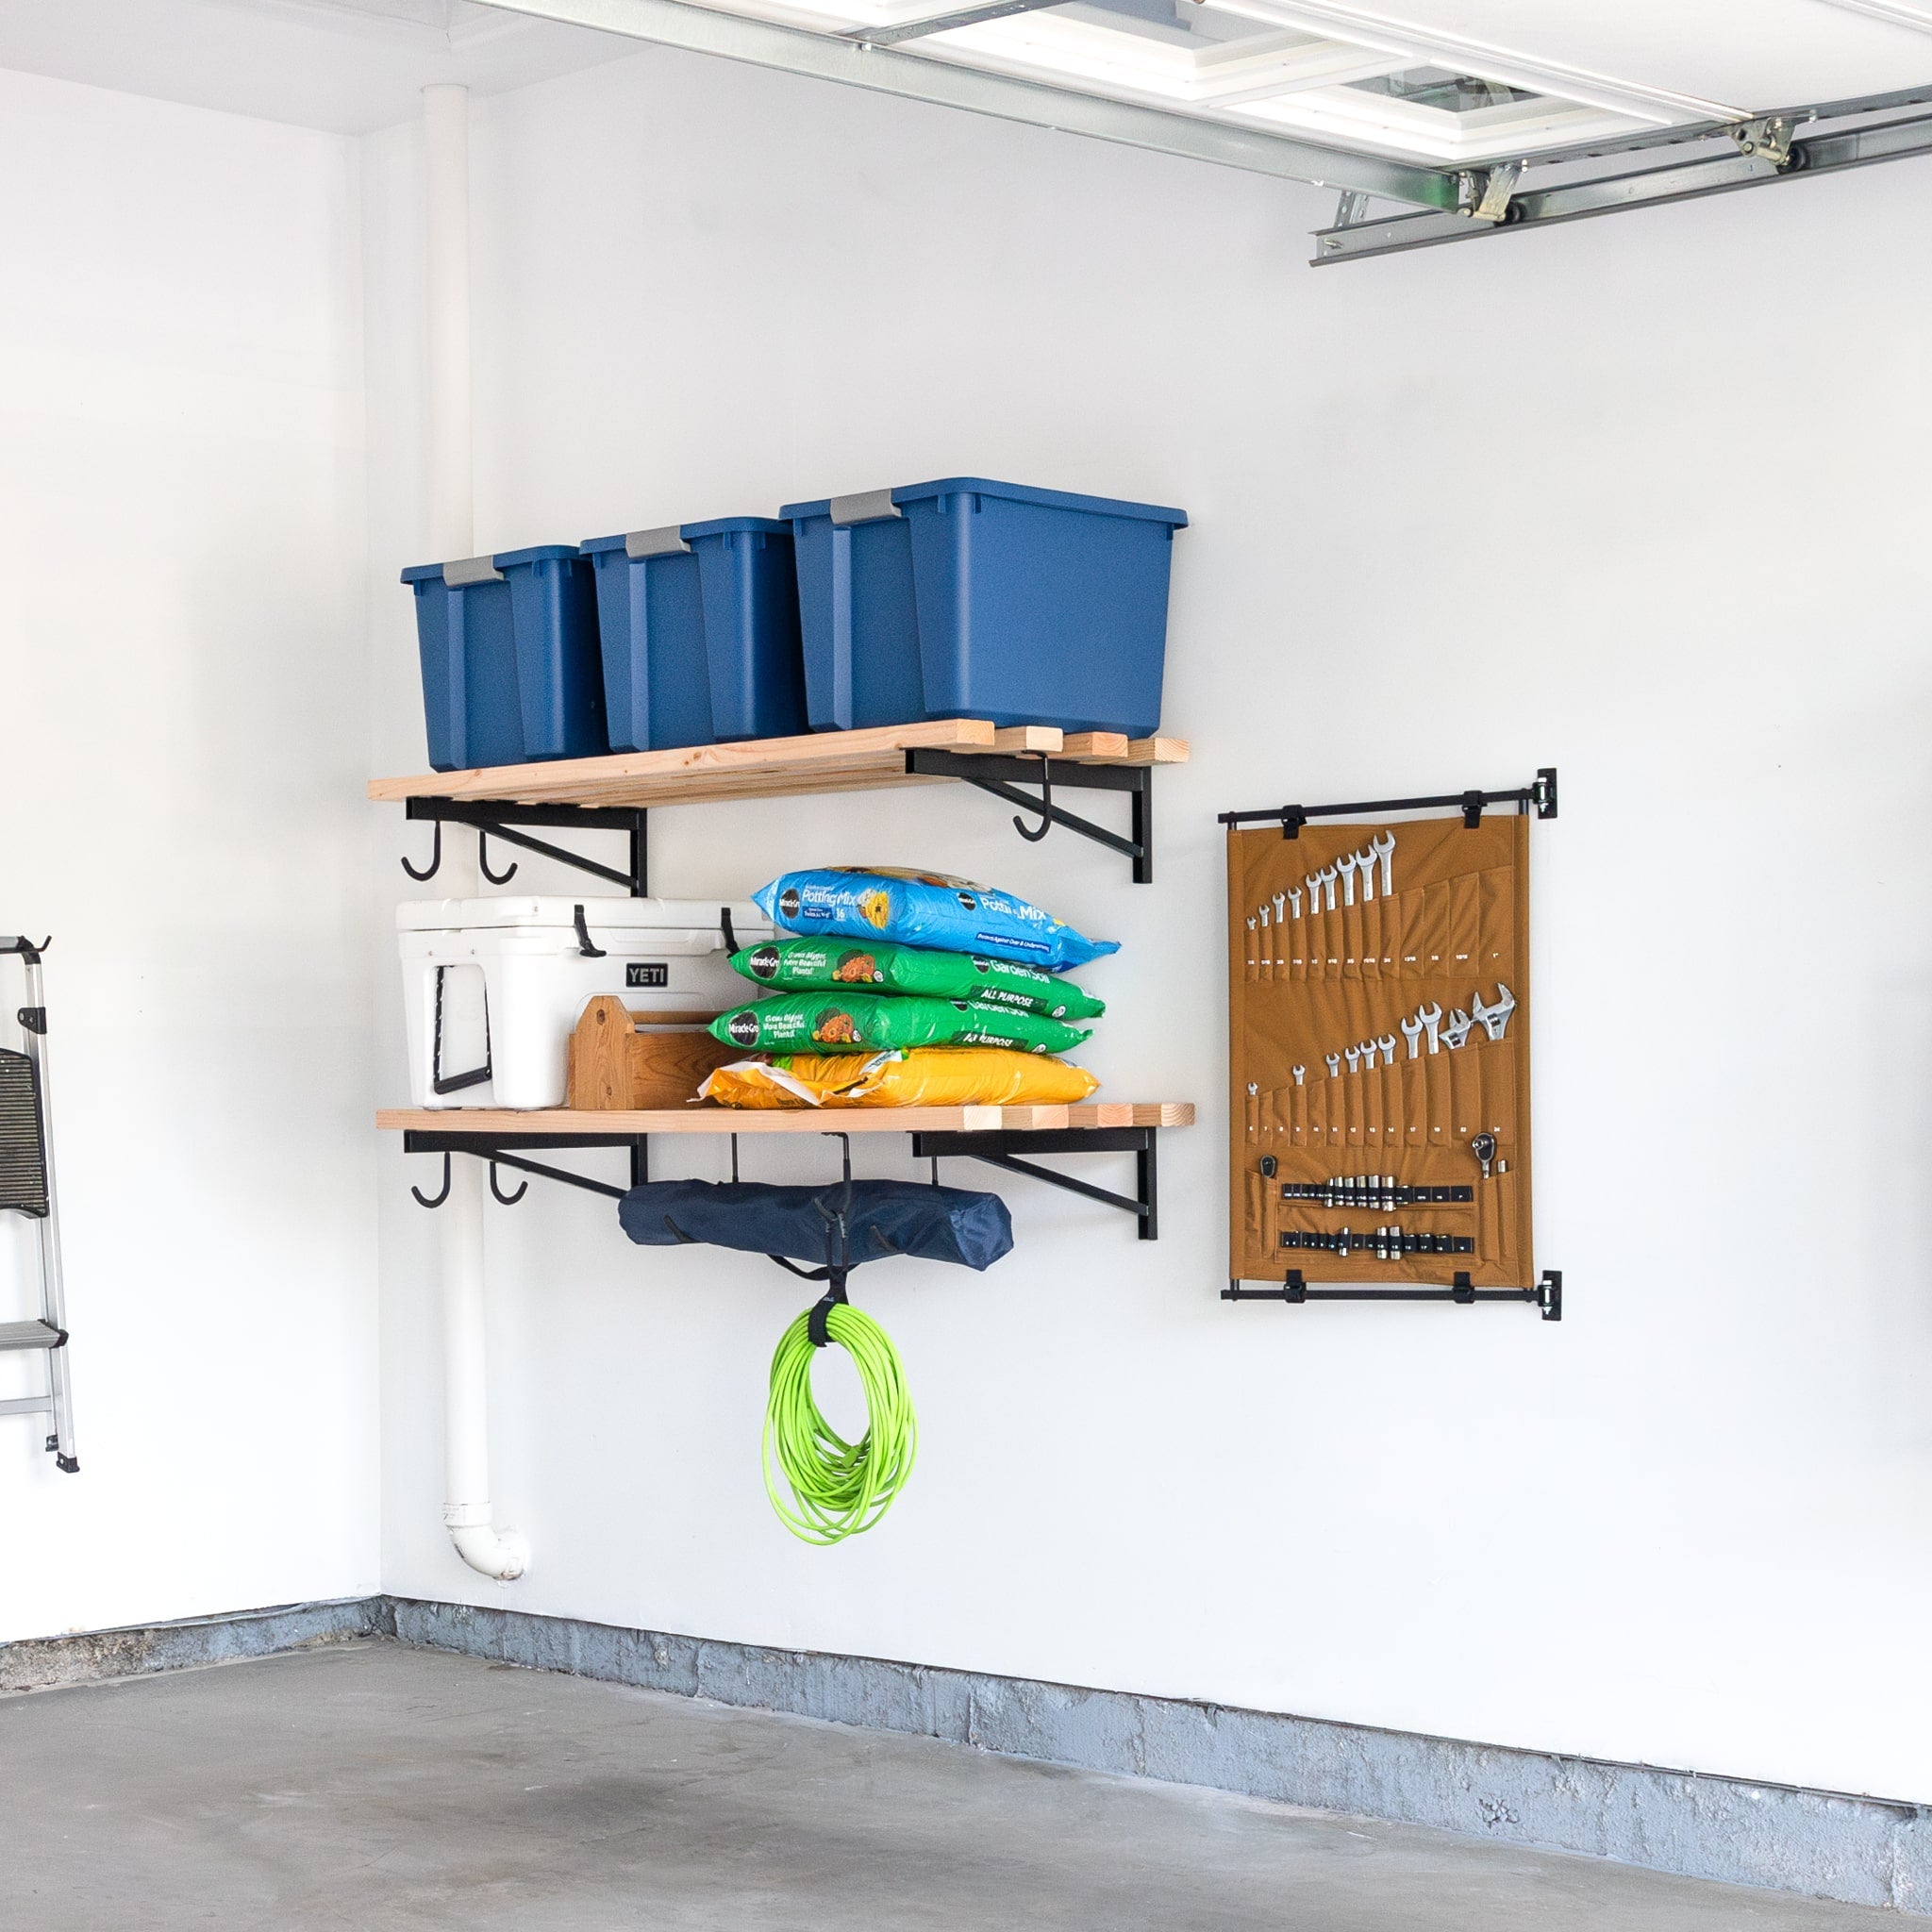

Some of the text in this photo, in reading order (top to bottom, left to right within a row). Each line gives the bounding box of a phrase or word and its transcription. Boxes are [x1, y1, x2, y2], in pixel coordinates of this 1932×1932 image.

[802, 889, 857, 907] Potting Mix
[980, 897, 1024, 920] Potti
[1020, 907, 1047, 921] Mix
[628, 967, 665, 983] YETI
[981, 989, 1033, 1007] ALL PURPOSE
[728, 1023, 759, 1034] Miracle-Gro
